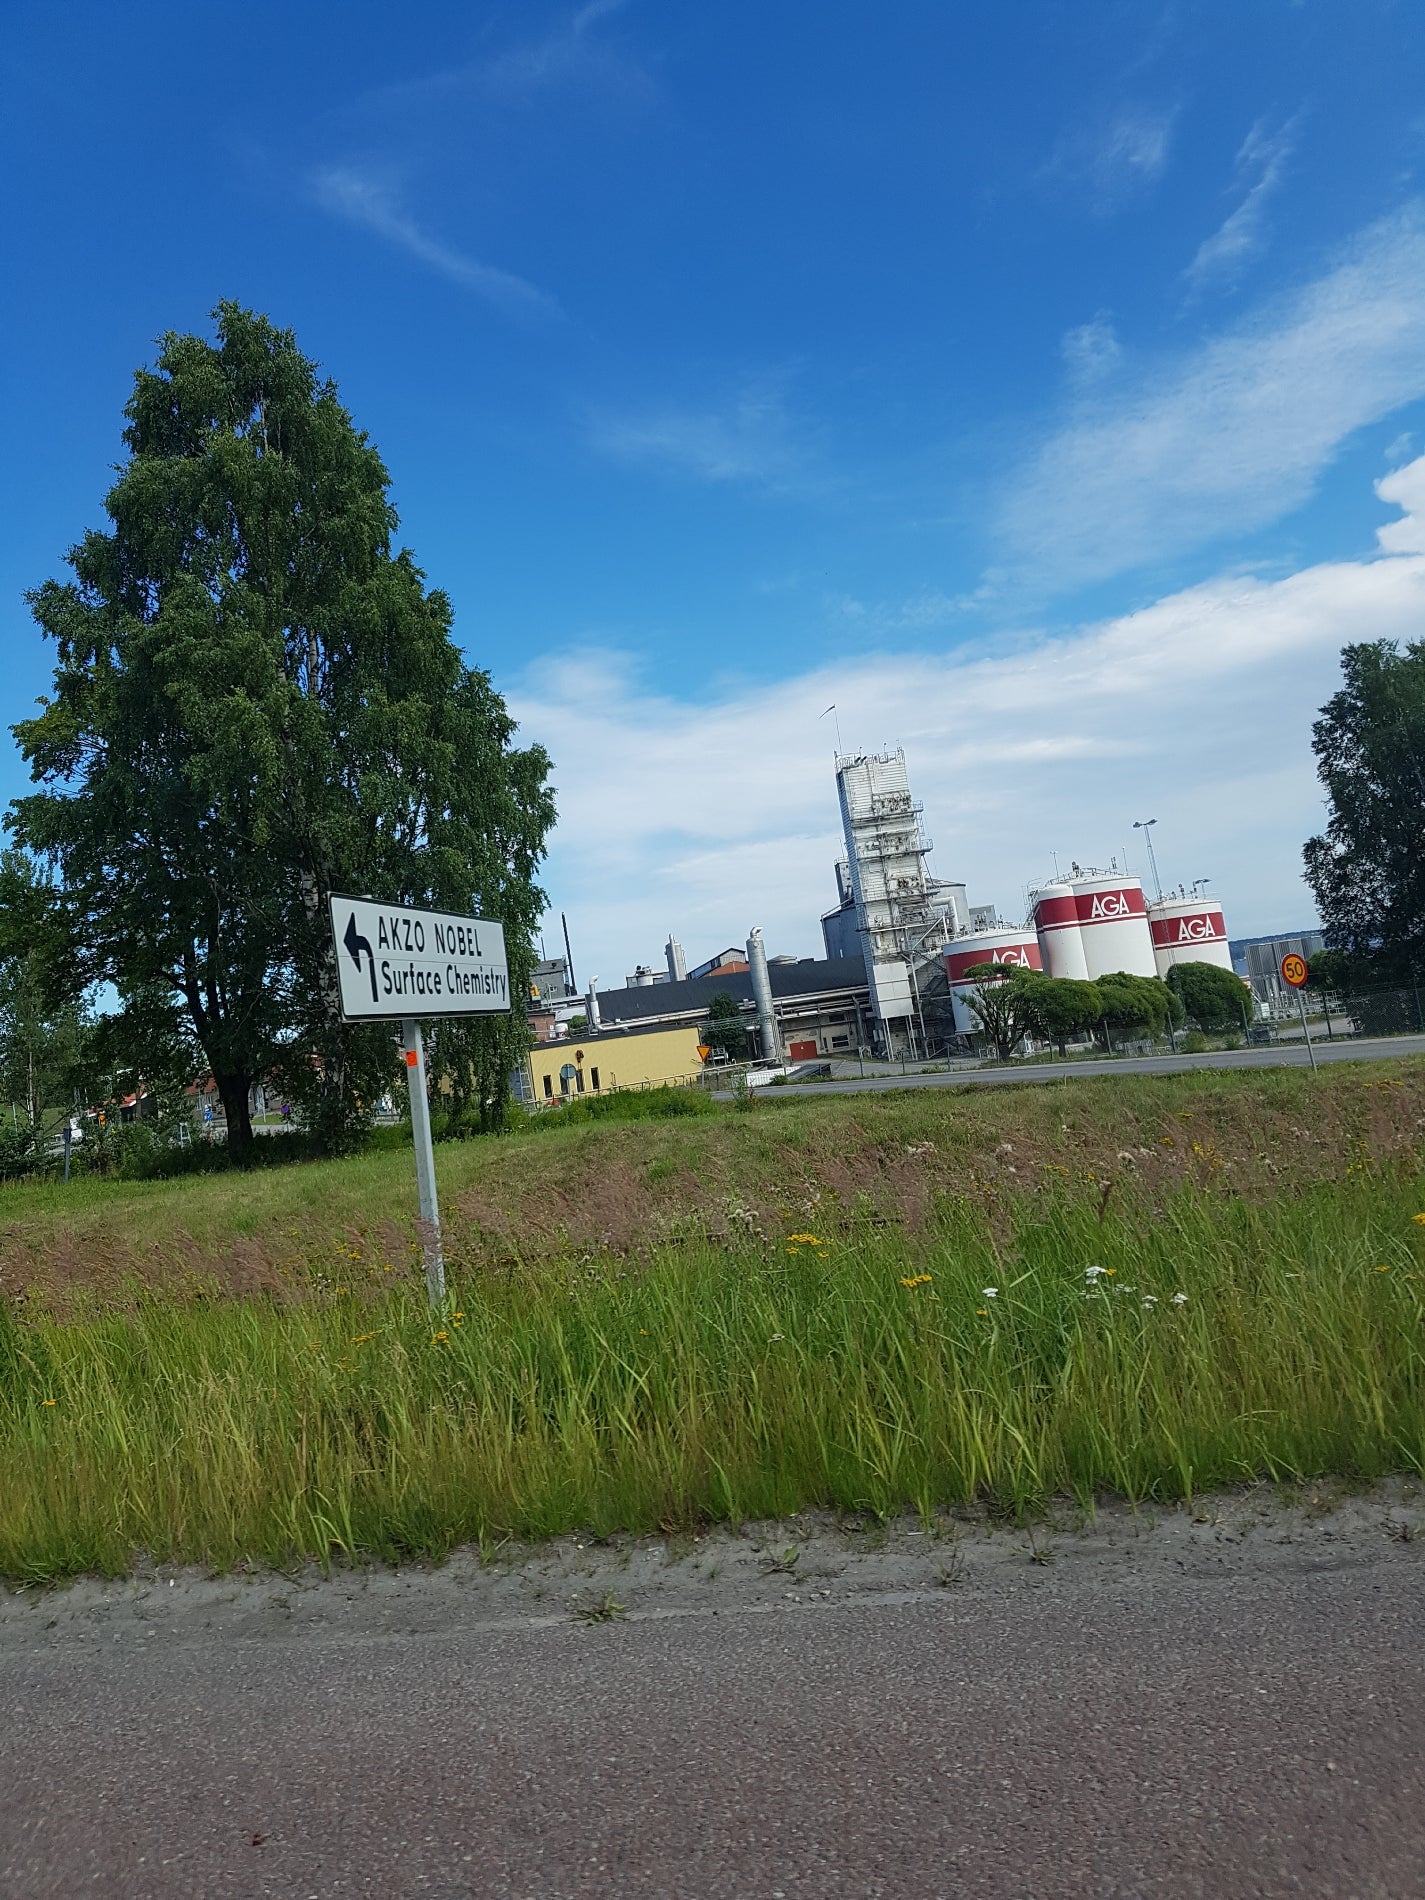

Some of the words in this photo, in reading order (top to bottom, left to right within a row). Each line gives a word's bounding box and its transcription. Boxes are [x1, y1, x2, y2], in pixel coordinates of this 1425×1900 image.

[1091, 891, 1129, 918] AGA
[379, 916, 425, 952] AKZO
[434, 923, 482, 957] NOBEL
[1178, 914, 1215, 940] AGA
[381, 960, 442, 995] Surface
[446, 963, 506, 1001] Chemistry
[1285, 961, 1304, 979] 50
